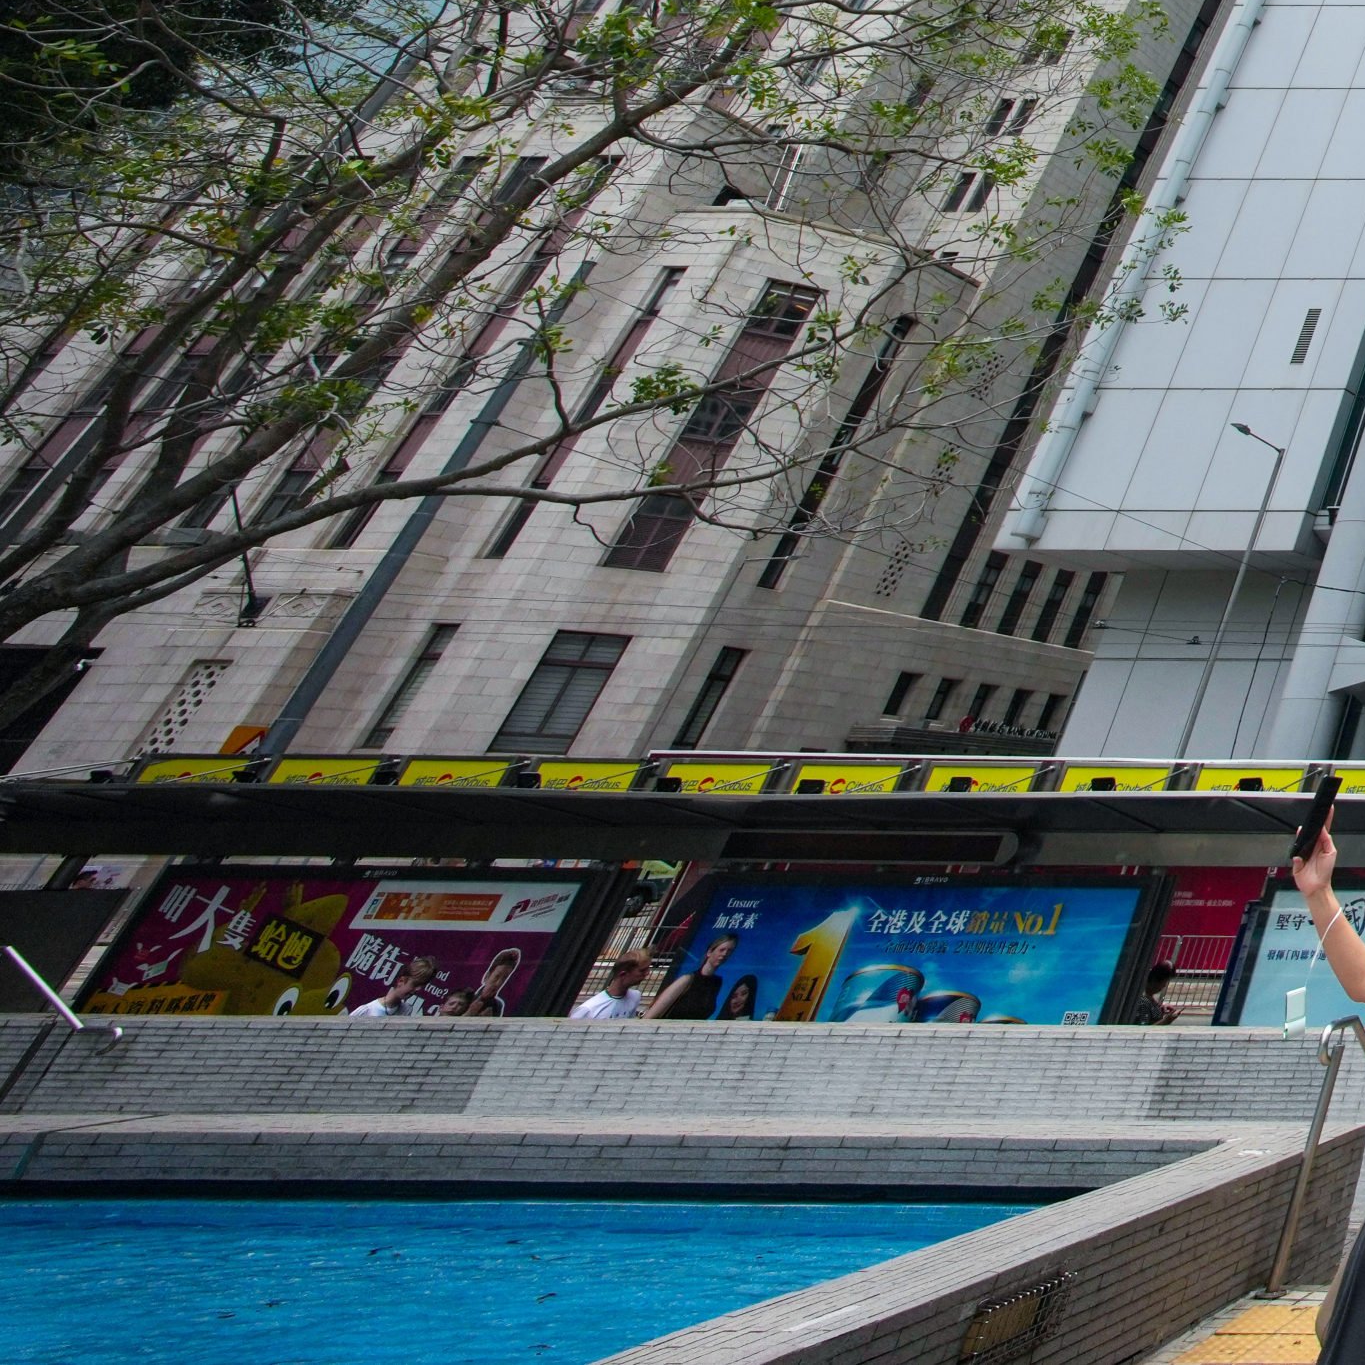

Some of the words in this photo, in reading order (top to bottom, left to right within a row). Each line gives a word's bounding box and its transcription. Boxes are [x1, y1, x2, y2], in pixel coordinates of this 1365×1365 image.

[924, 876, 949, 884] BRAVO
[726, 898, 761, 909] Ensure
[712, 912, 759, 930] 加營素
[425, 982, 449, 999] true?
